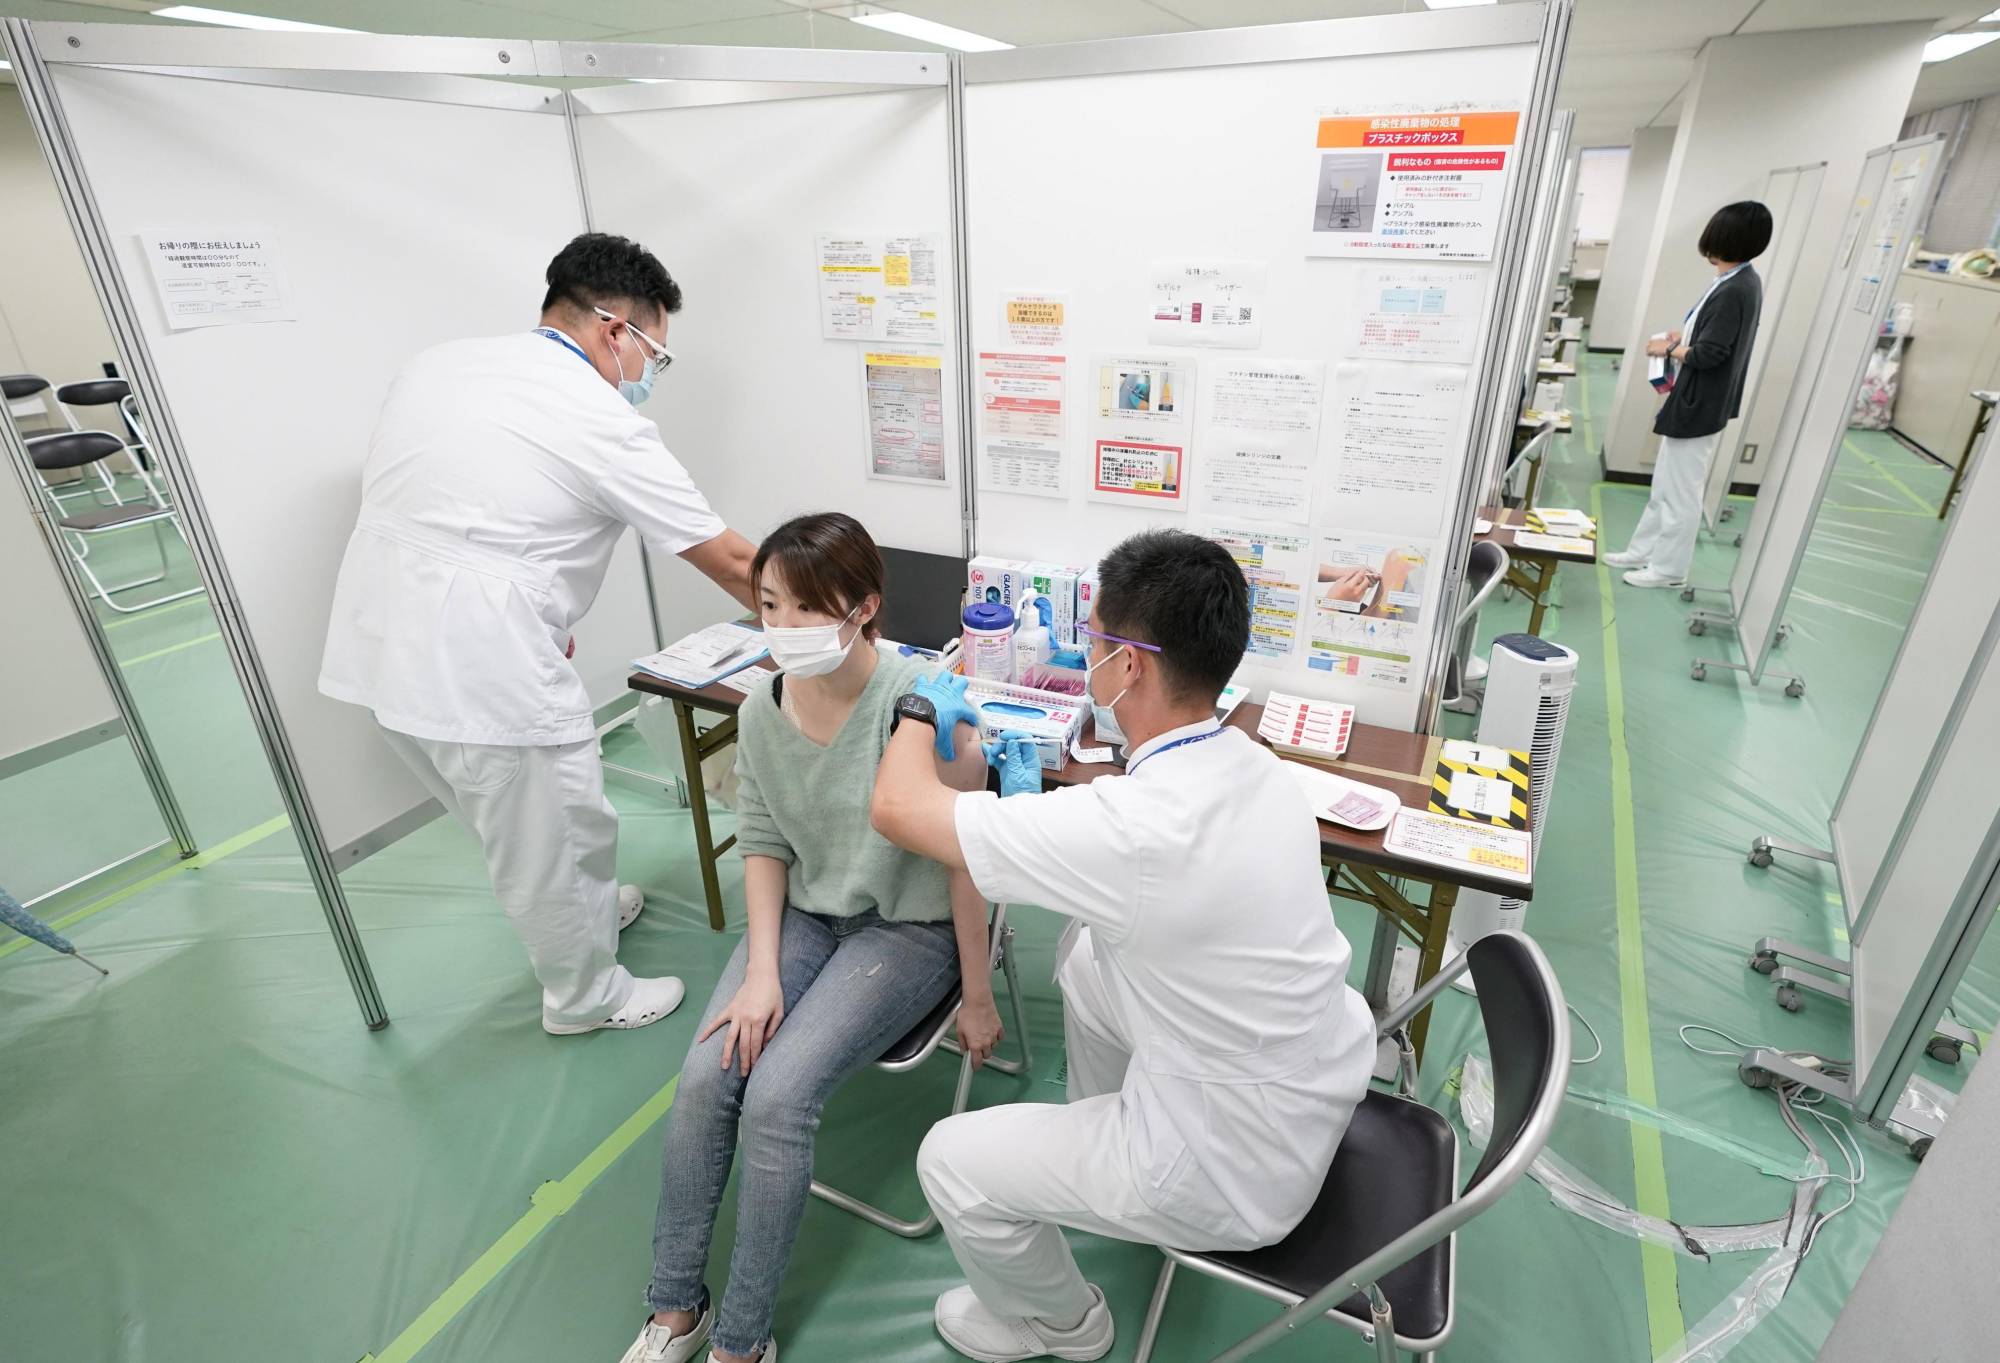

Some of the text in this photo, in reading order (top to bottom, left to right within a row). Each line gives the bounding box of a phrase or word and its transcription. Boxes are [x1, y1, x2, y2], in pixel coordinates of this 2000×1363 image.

[1370, 117, 1460, 129] 感染性廃棄物の処理
[1368, 132, 1458, 144] プラスチックボックス
[159, 241, 261, 250] お帰りの際にお伝えしましょう
[1003, 573, 1011, 606] GLACIER
